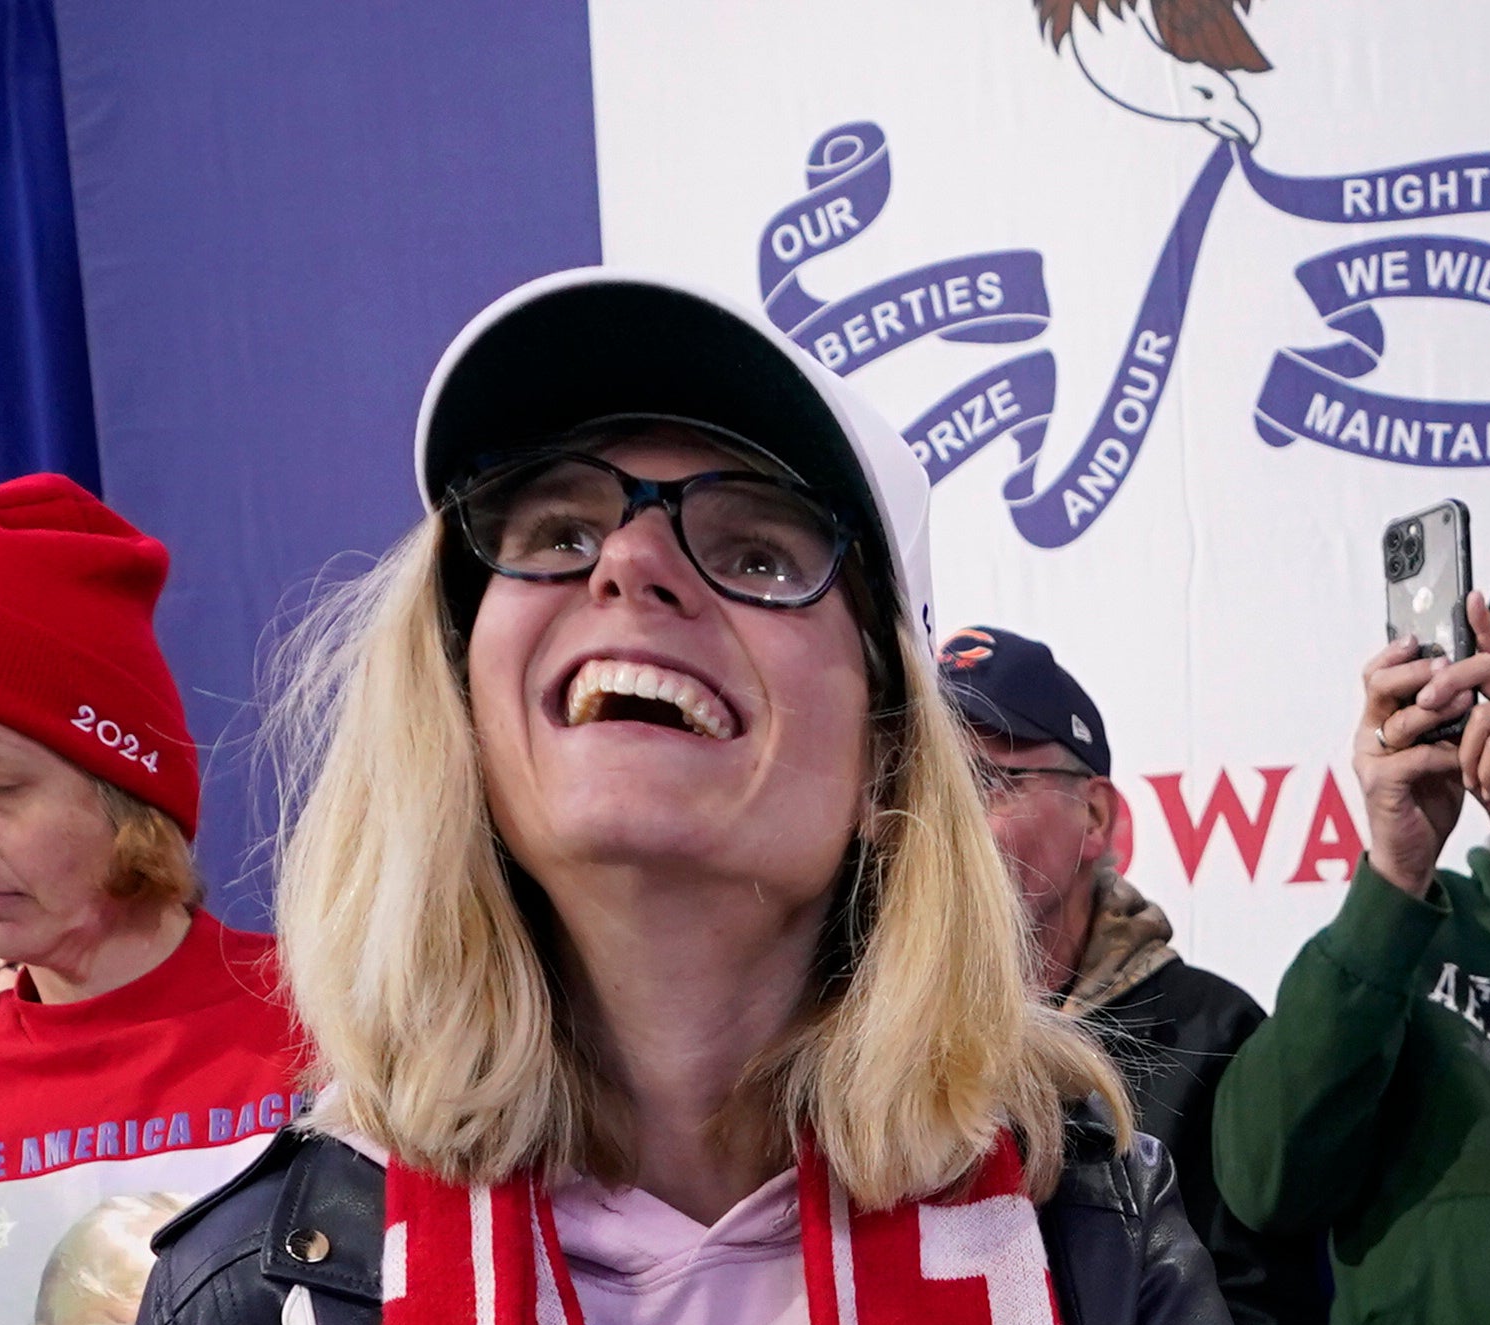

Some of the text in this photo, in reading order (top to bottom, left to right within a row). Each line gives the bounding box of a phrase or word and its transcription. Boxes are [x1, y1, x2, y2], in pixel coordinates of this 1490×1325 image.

[770, 196, 861, 262] OUR
[1336, 250, 1410, 299] WE
[814, 271, 1005, 371] BERTIES
[1062, 329, 1172, 528] AND OUR
[70, 704, 159, 774] 2024
[1113, 765, 1364, 885] WA
[19, 1112, 192, 1175] AMERICA
